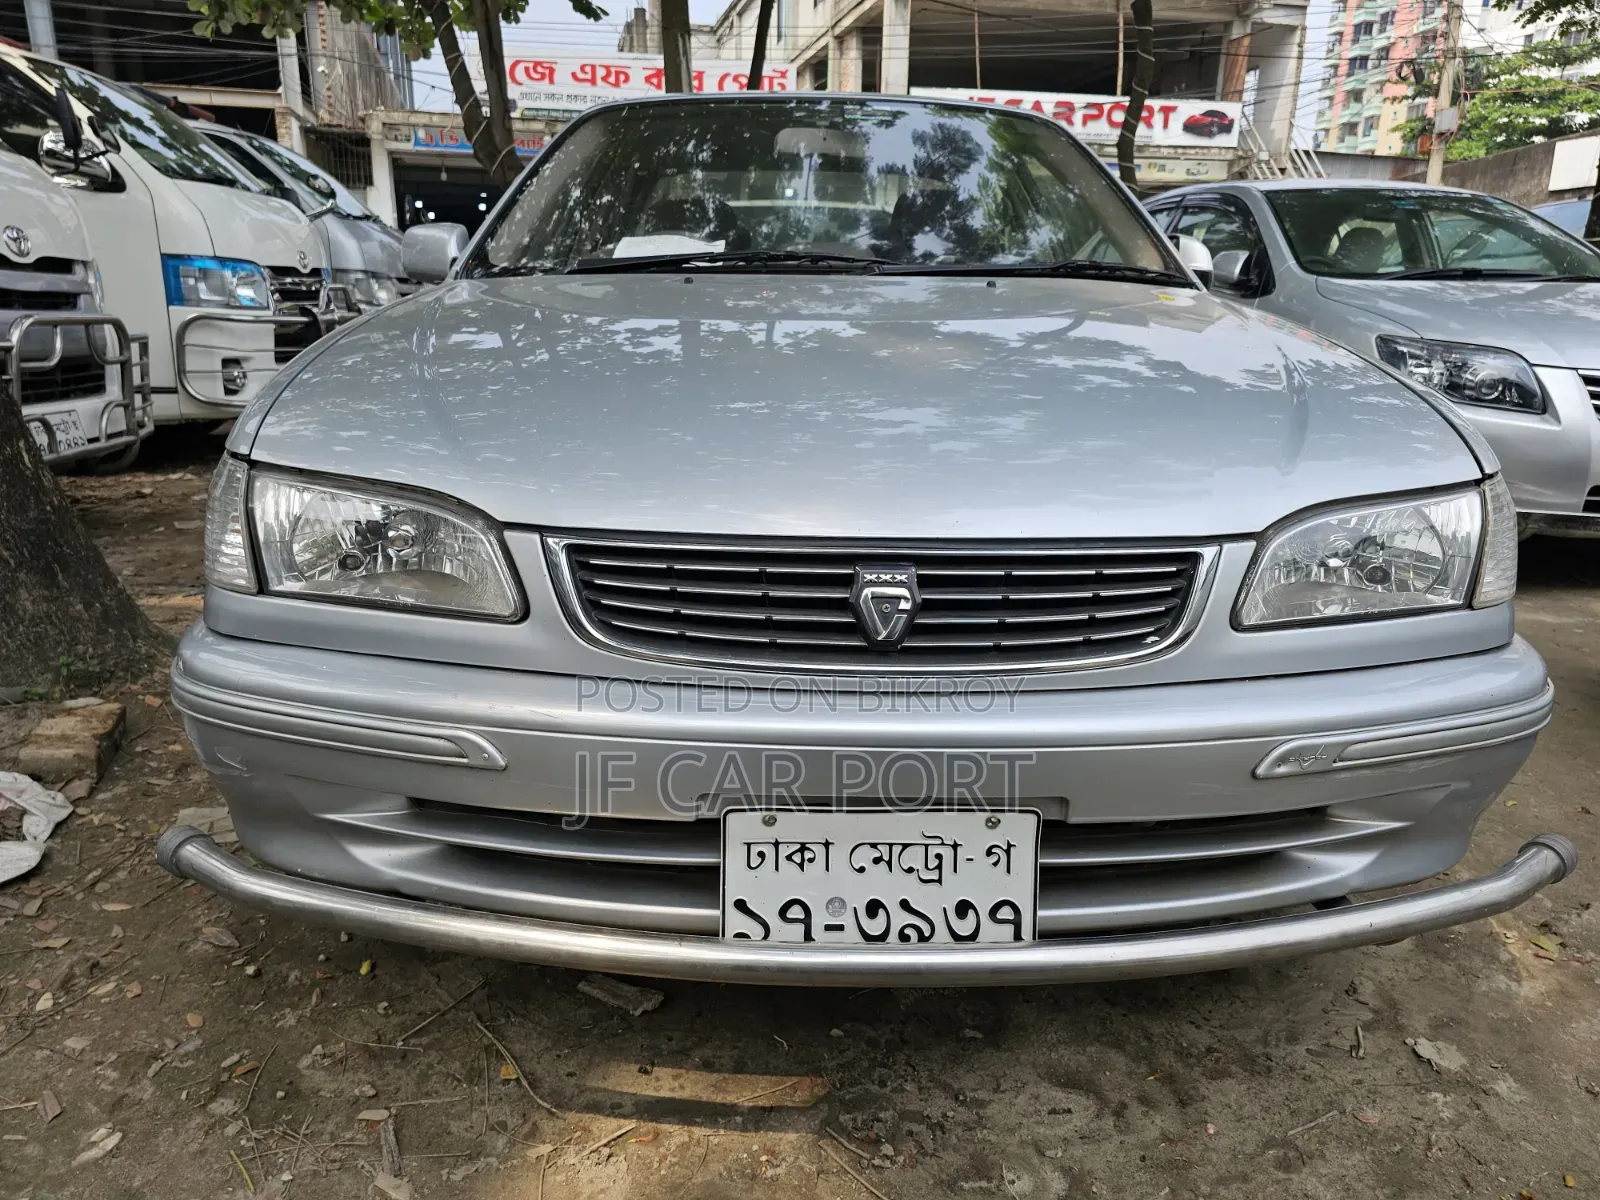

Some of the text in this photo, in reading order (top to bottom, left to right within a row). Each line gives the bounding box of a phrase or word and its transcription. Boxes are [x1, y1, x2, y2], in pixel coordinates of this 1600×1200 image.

[508, 60, 558, 86] জে
[571, 63, 631, 88] এফ
[1082, 102, 1178, 129] PORT
[743, 837, 835, 873] ঢাকা
